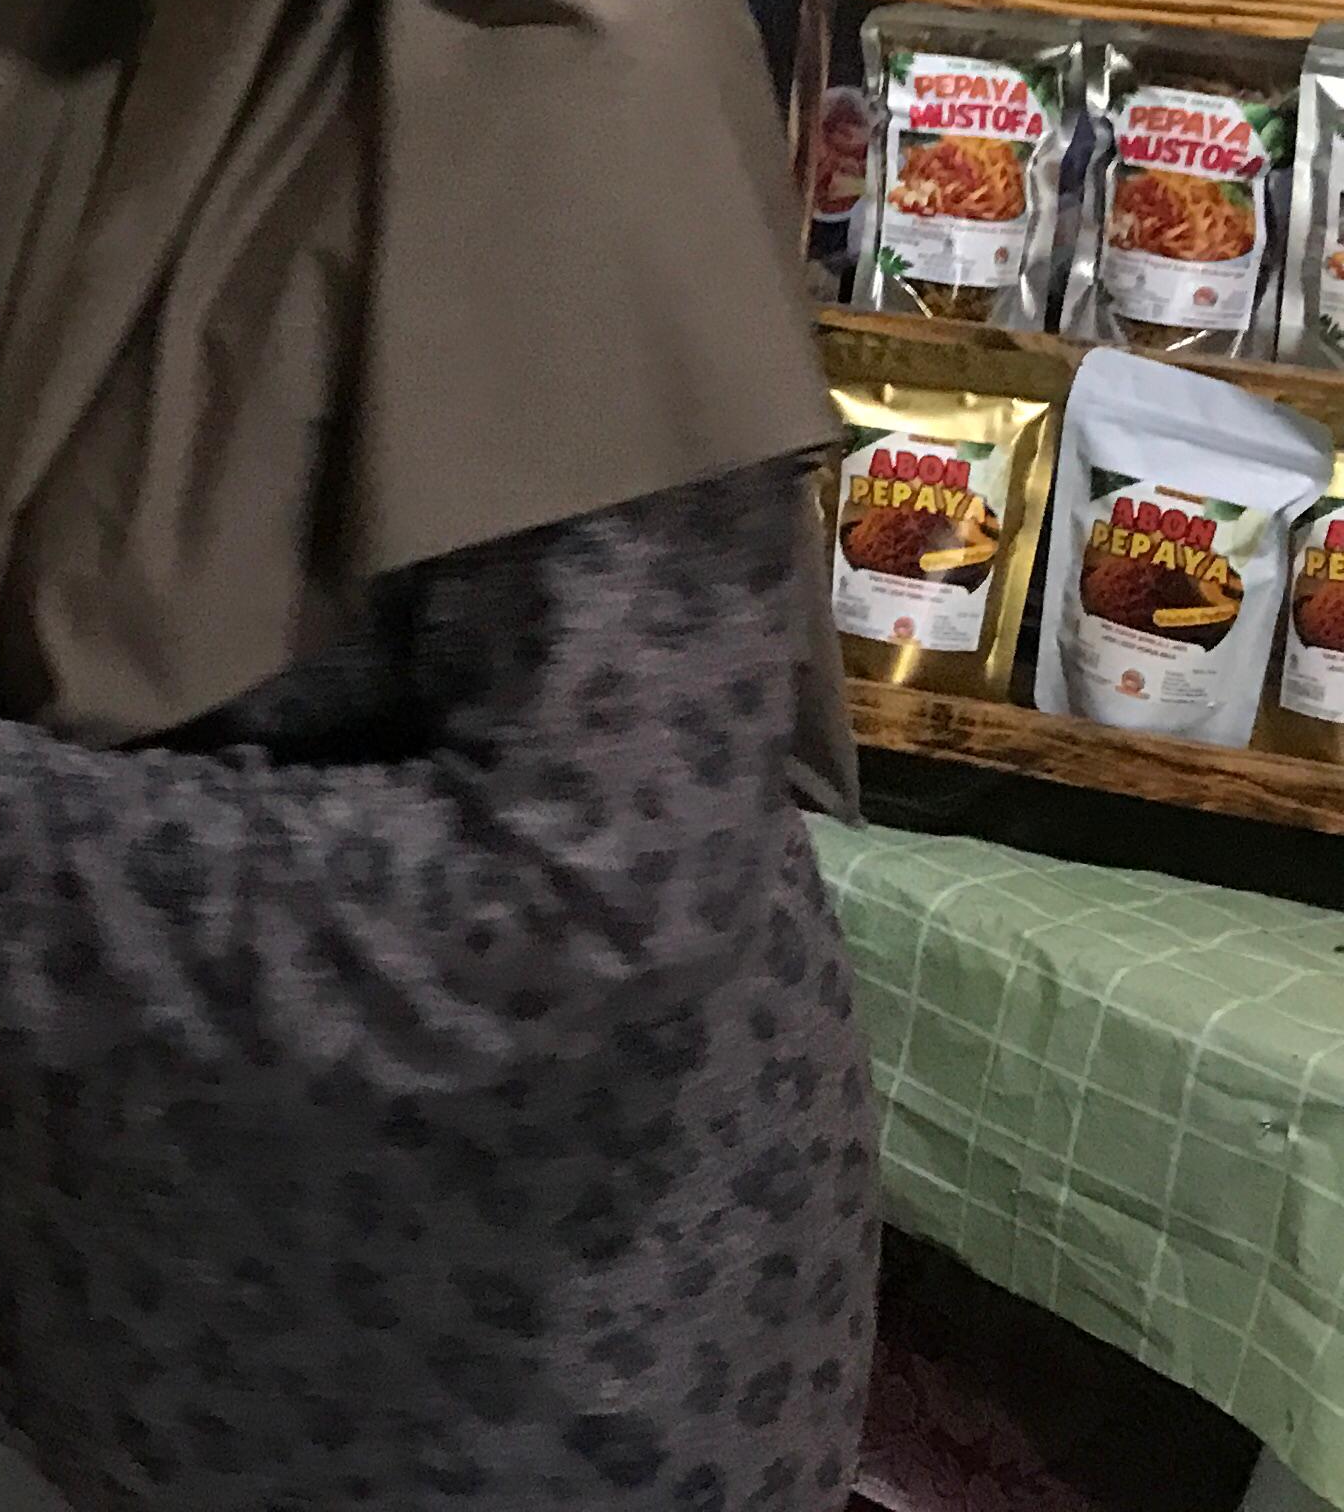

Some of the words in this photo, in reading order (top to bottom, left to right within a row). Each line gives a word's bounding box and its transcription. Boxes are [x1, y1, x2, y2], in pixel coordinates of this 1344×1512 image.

[913, 73, 1029, 105] PEPAYA
[909, 102, 1043, 138] MUSTOFA
[1128, 105, 1253, 148] PEPAYA
[1119, 134, 1265, 179] MUSTOFA
[868, 447, 972, 490] ABON
[850, 474, 987, 525] PEPAYA
[1110, 496, 1218, 552] ABON
[1091, 519, 1229, 585] PEPAYA
